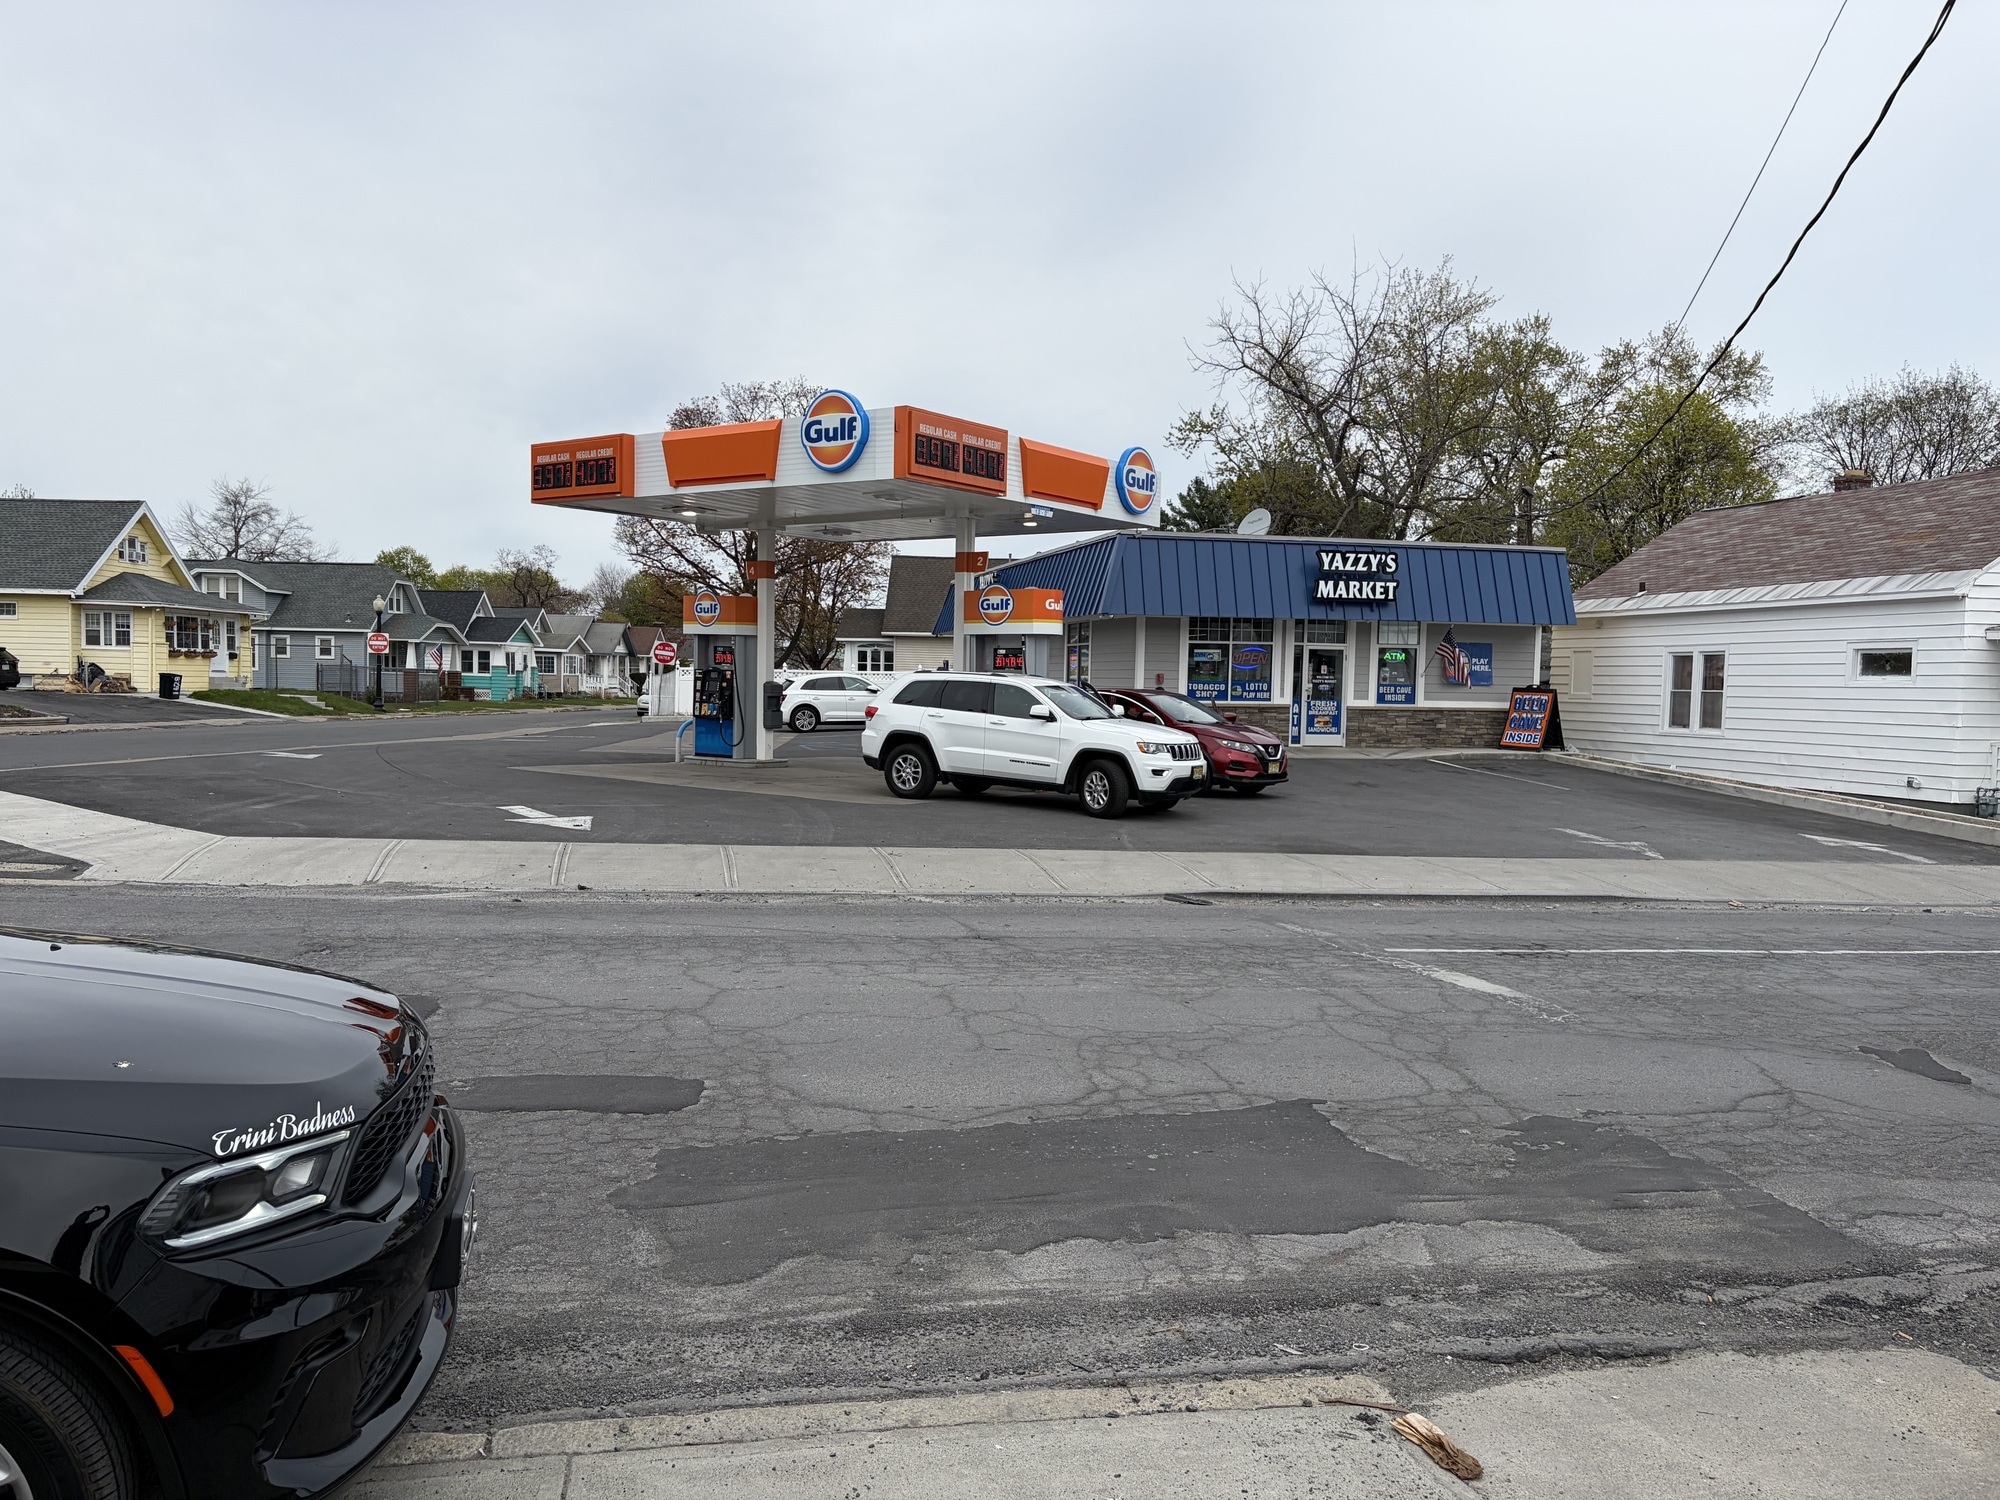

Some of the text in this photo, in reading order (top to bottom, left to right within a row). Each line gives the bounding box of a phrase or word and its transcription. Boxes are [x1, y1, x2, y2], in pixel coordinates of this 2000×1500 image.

[804, 416, 857, 444] Gulf
[919, 423, 957, 440] REGULAR CASH
[962, 433, 1002, 450] REGULAR CREDIT
[537, 452, 570, 463] REGULAR CASH
[575, 447, 614, 460] REGULAR CREDIT
[1125, 467, 1156, 493] Gulf
[976, 556, 984, 567] 2
[1319, 552, 1397, 573] YAZZY'S
[748, 566, 755, 576] 4
[1316, 580, 1398, 600] MARKET
[695, 603, 718, 614] Gulf
[980, 598, 1011, 611] Gulf
[1045, 598, 1063, 611] Gul
[1232, 652, 1269, 665] OPEN
[1383, 652, 1406, 661] ATM
[1471, 657, 1489, 665] PLAY
[1471, 664, 1492, 672] HERE.
[1188, 683, 1226, 691] TOBACCO
[1245, 683, 1268, 691] LOTTO
[1379, 686, 1412, 694] BEER CAVE
[1195, 690, 1218, 698] SHOP
[1242, 691, 1270, 699] PLAY HERE
[1513, 694, 1549, 713] BEER
[1291, 703, 1299, 737] ATM
[1509, 712, 1545, 731] CAVE
[1503, 731, 1541, 745] INSIDE
[211, 1100, 356, 1156] Trini Badness
